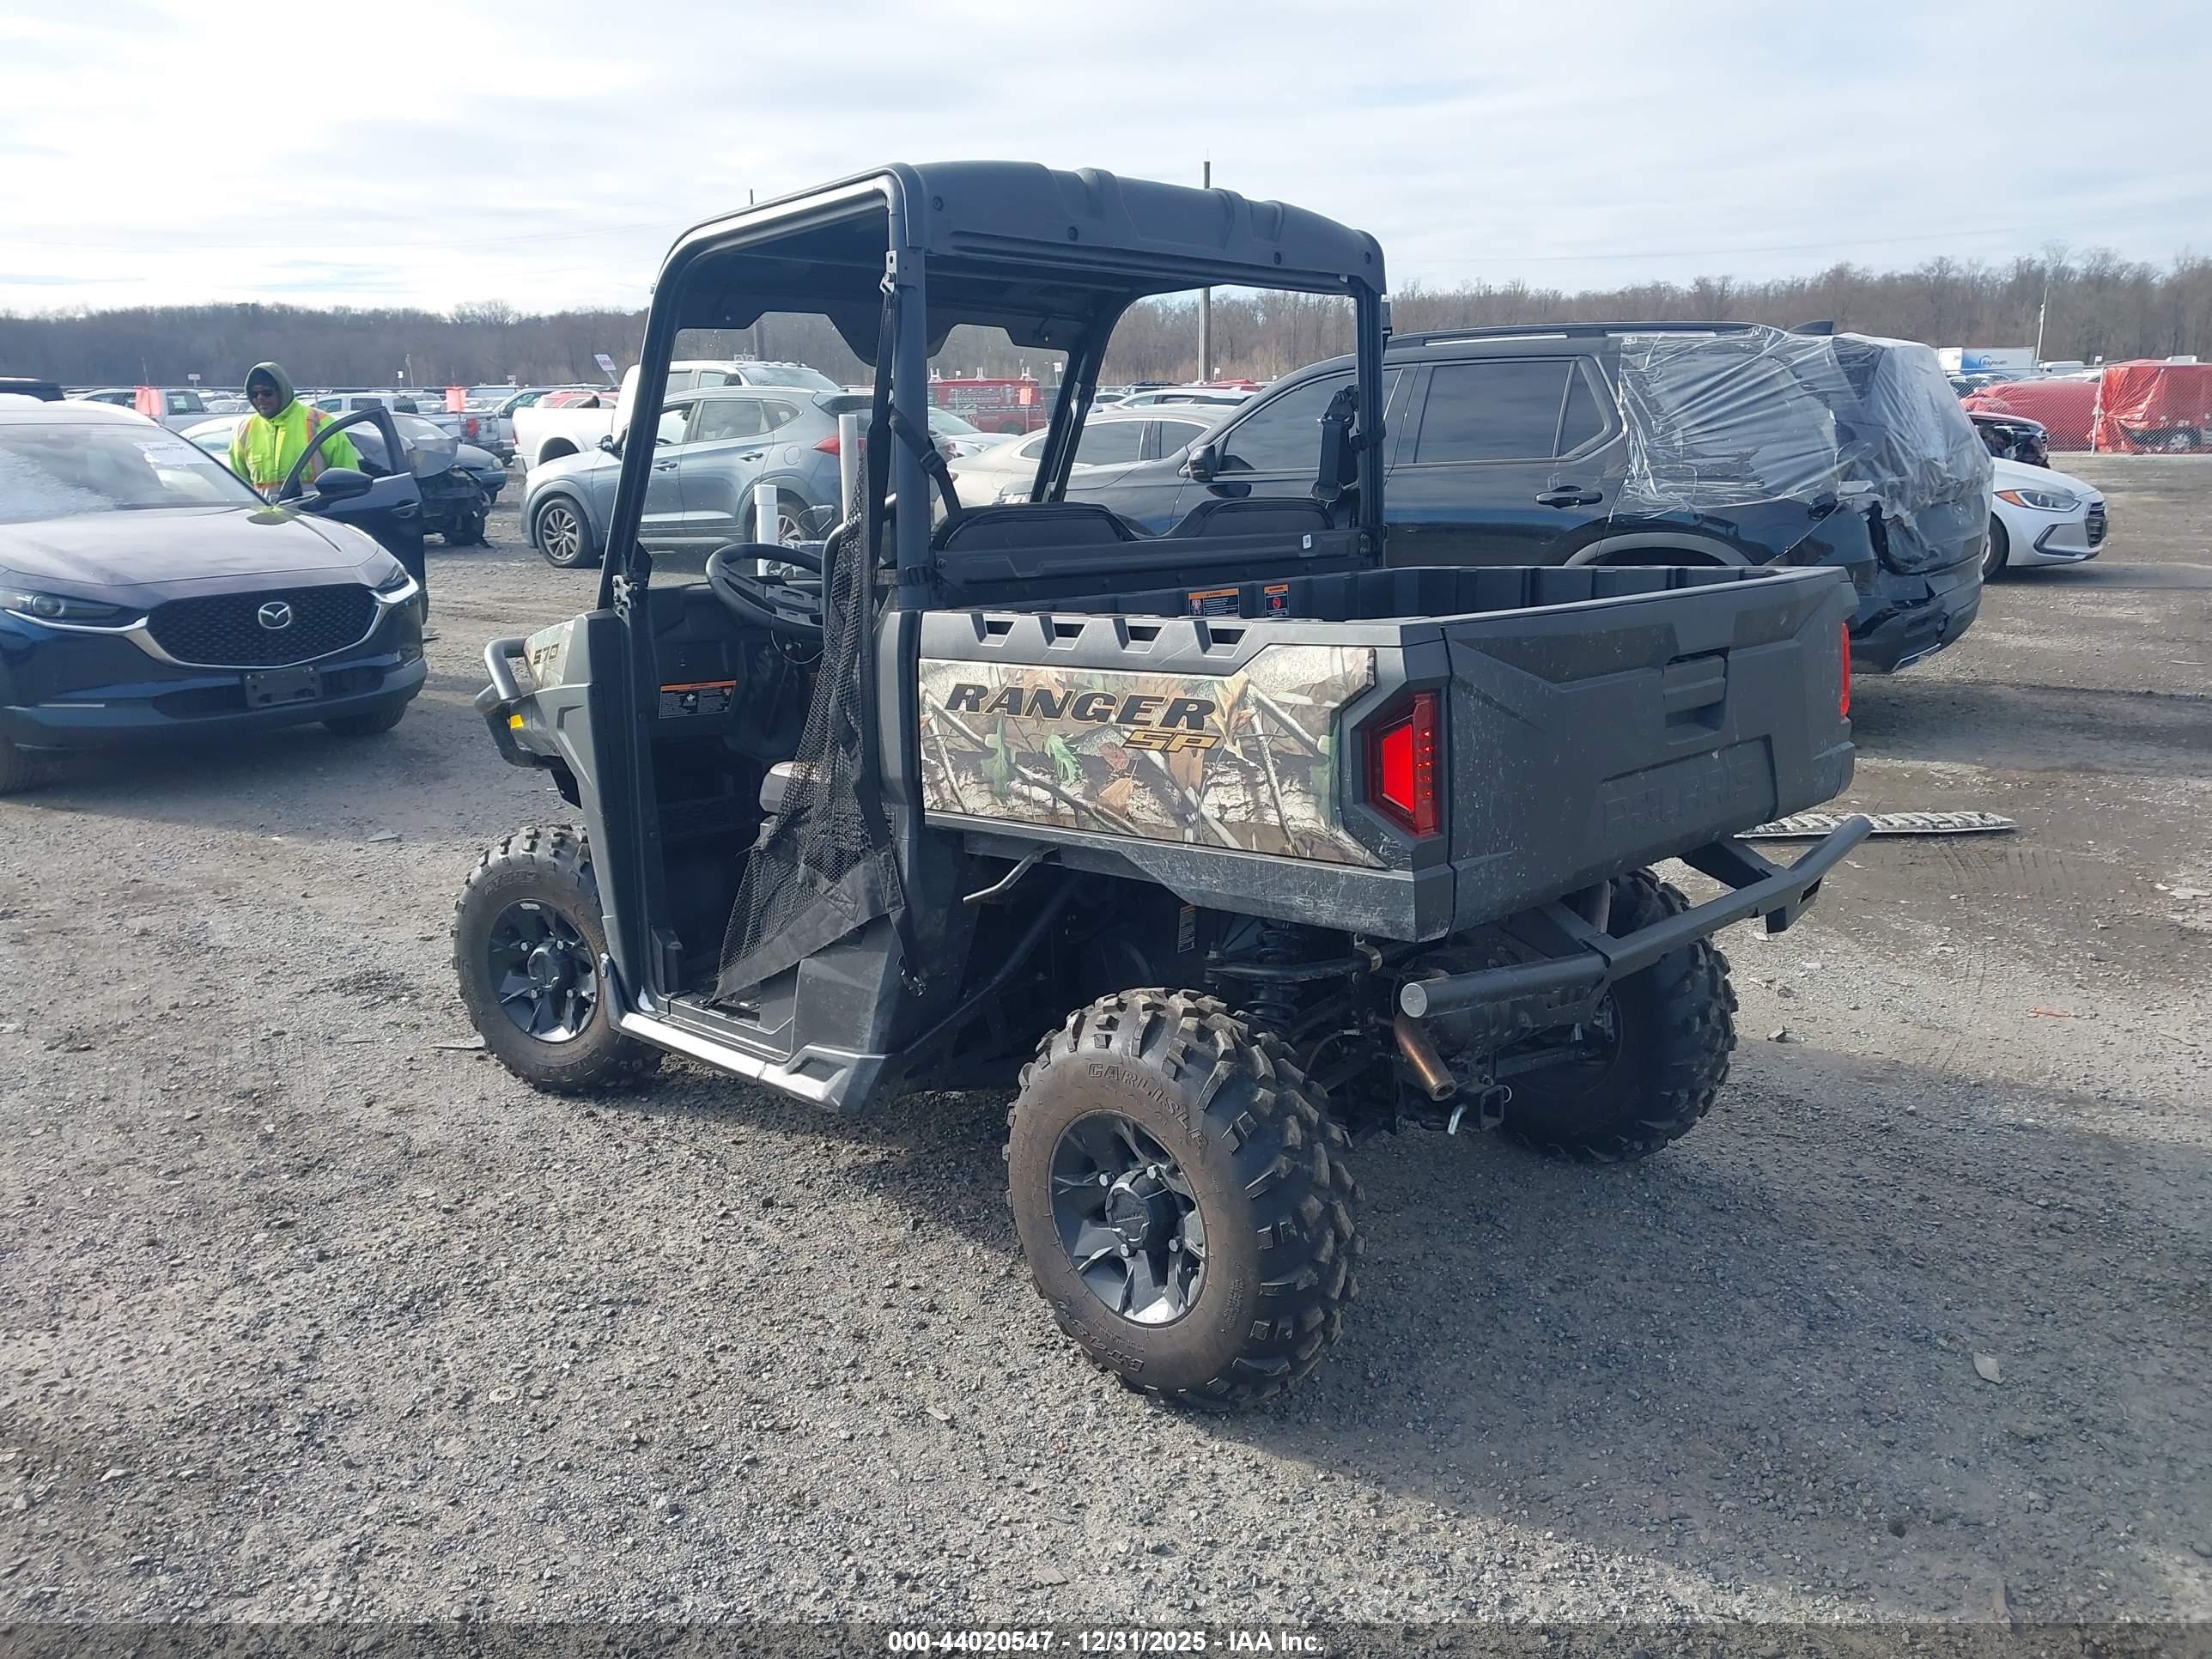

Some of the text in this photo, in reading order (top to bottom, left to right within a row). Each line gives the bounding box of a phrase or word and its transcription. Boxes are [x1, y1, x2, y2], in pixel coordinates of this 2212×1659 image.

[532, 643, 559, 665] 570
[944, 683, 1217, 732] RANGER
[1122, 729, 1221, 753] SP
[1088, 1063, 1209, 1150] CARLISLE
